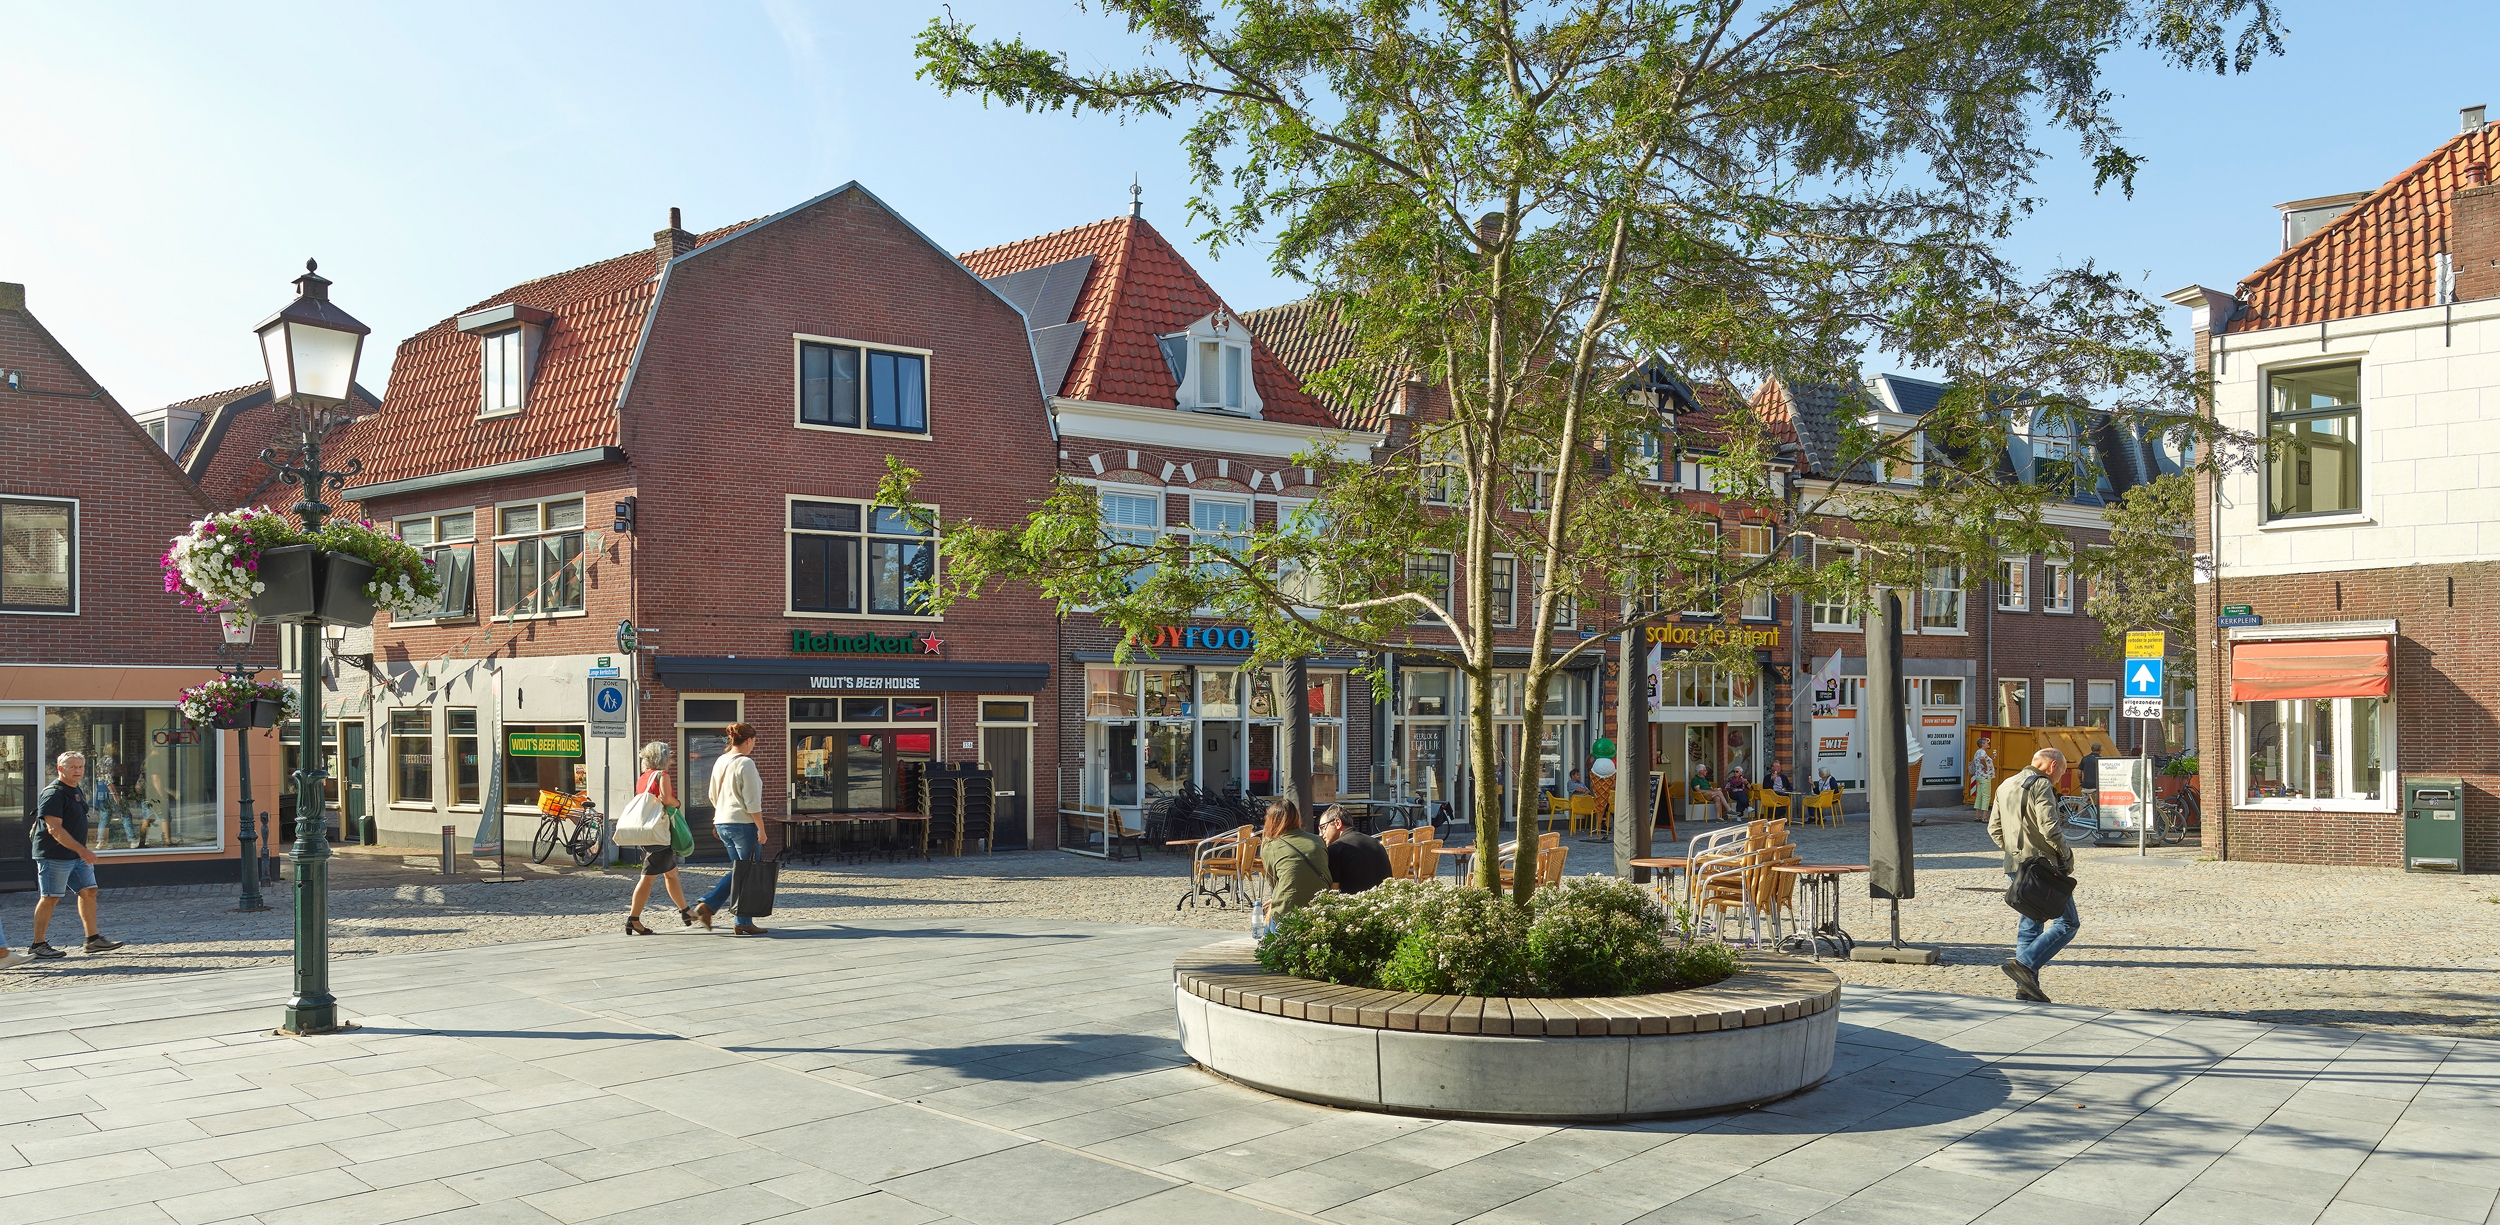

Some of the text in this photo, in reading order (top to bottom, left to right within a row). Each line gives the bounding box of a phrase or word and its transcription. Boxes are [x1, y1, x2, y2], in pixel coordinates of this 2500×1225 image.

[2220, 617, 2257, 625] KERKPLEIN
[1646, 622, 1695, 644] salon
[791, 629, 915, 654] Heineken
[810, 676, 921, 689] WOUT'S BEER HOUSE
[155, 731, 201, 745] OPEN
[1825, 739, 1843, 749] WIT
[511, 738, 580, 752] WOUT'S BEER HOUSE
[1410, 740, 1441, 751] EERLIJK
